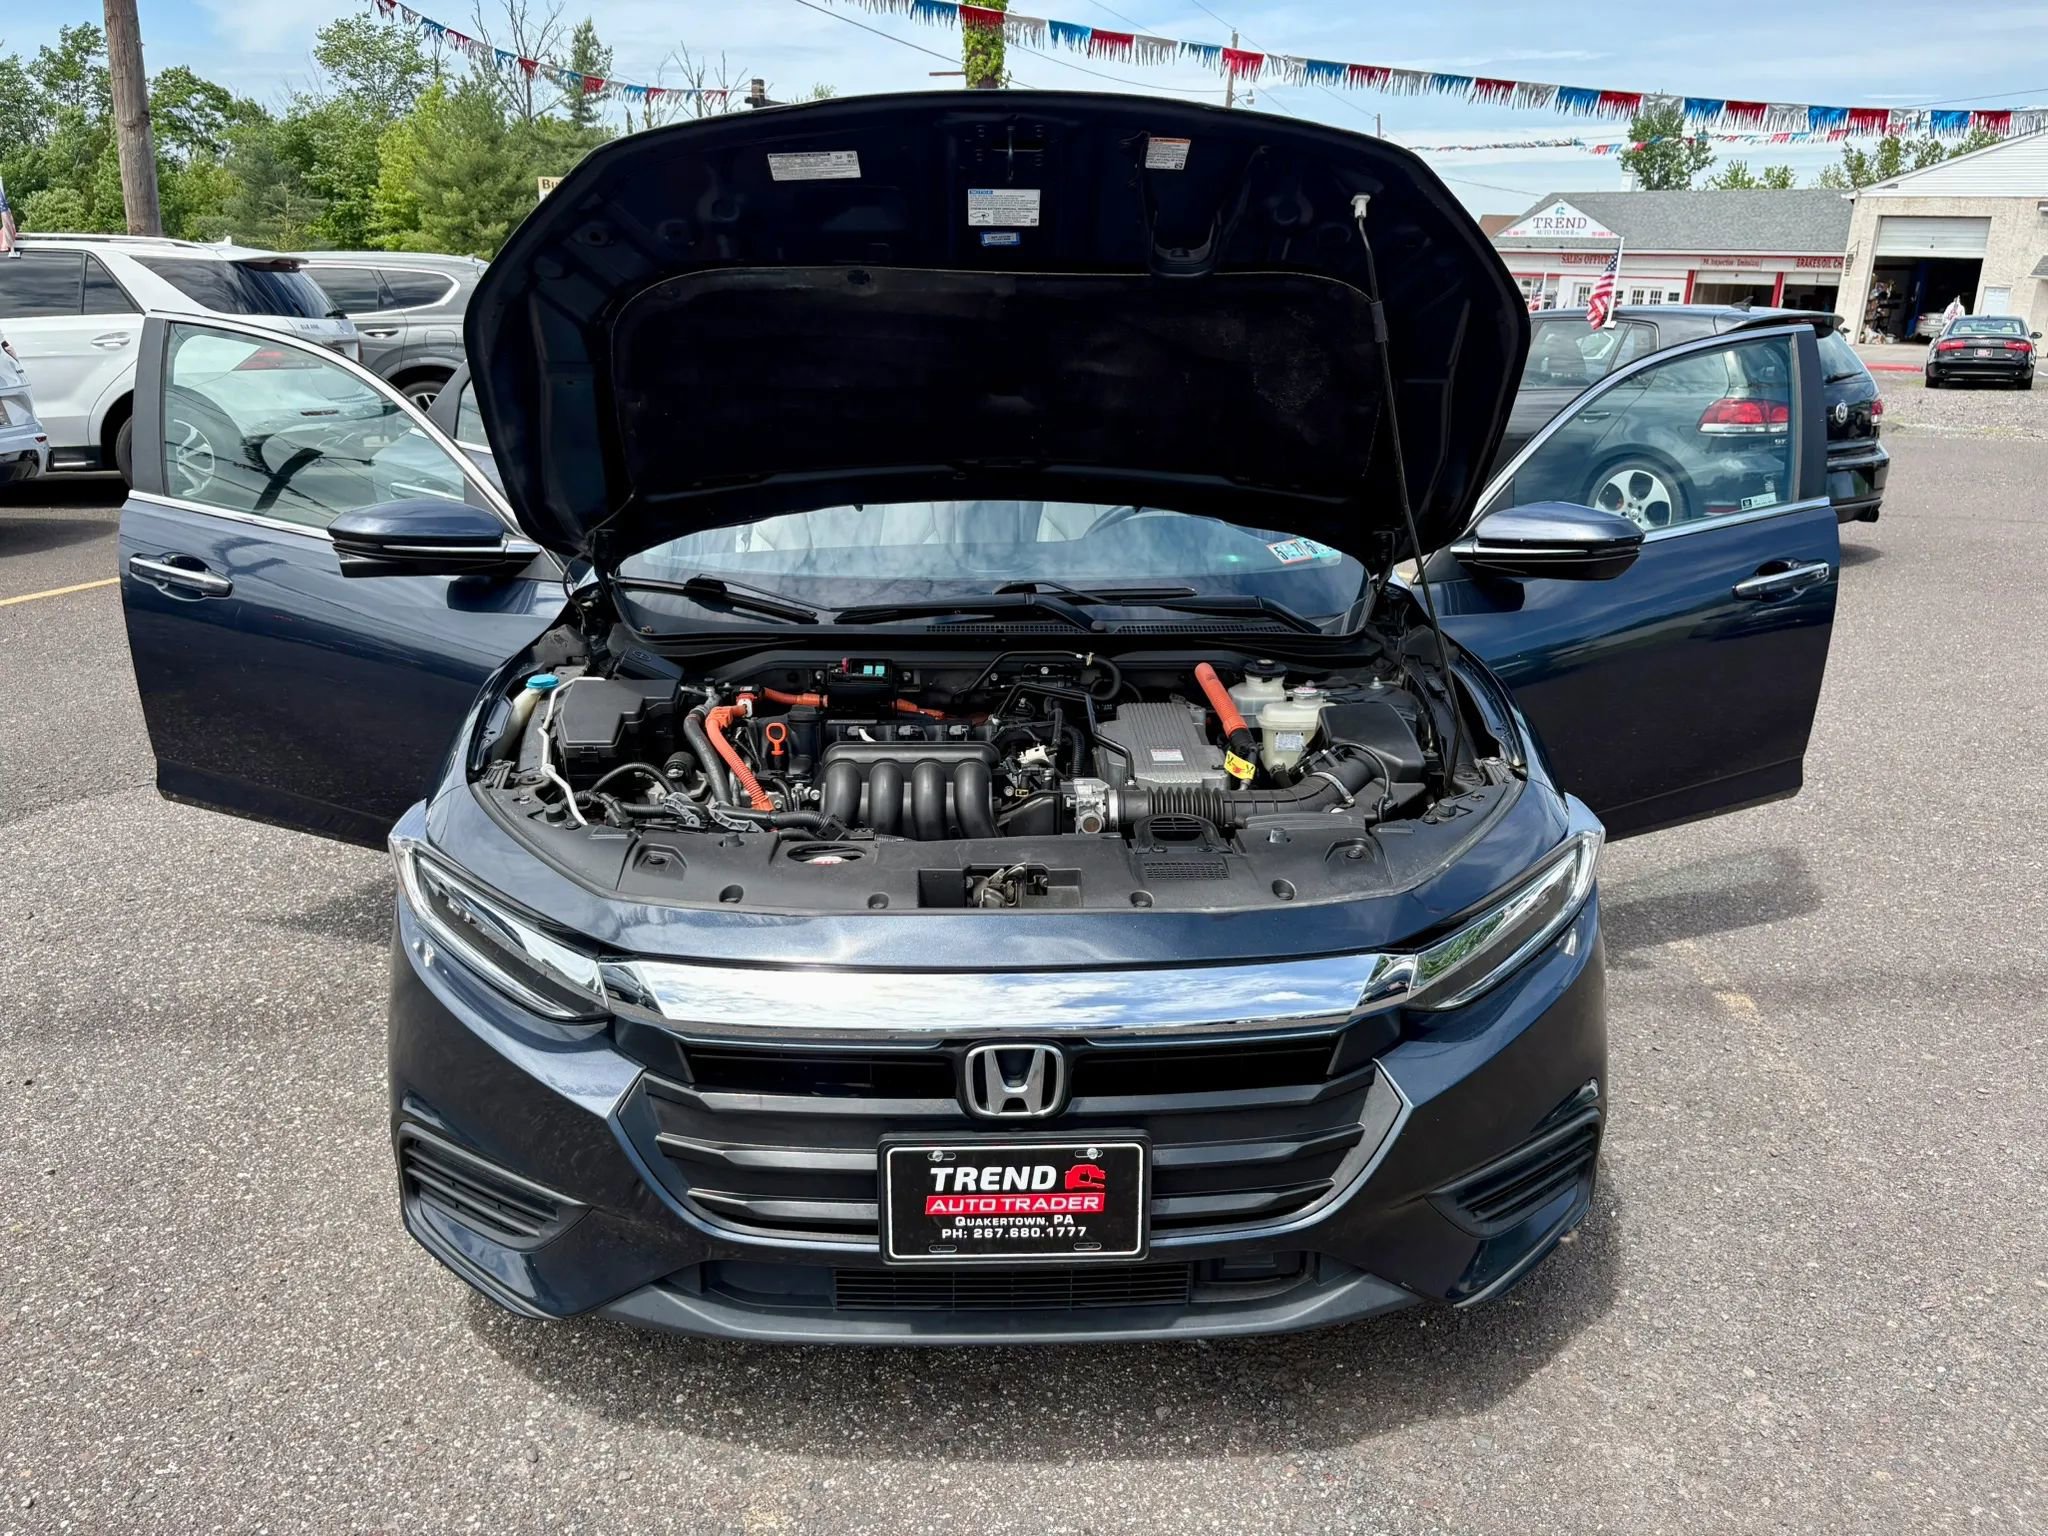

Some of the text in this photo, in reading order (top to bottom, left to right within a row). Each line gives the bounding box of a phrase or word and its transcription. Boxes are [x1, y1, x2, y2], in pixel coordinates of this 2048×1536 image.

[1533, 217, 1587, 229] TREND
[1561, 254, 1611, 265] SALES OFFICE
[930, 1166, 1057, 1192] TREND
[929, 1196, 1099, 1212] AUTO TRADER
[1053, 1215, 1074, 1226] PA
[942, 1226, 1087, 1239] PH: 267.680.1777
